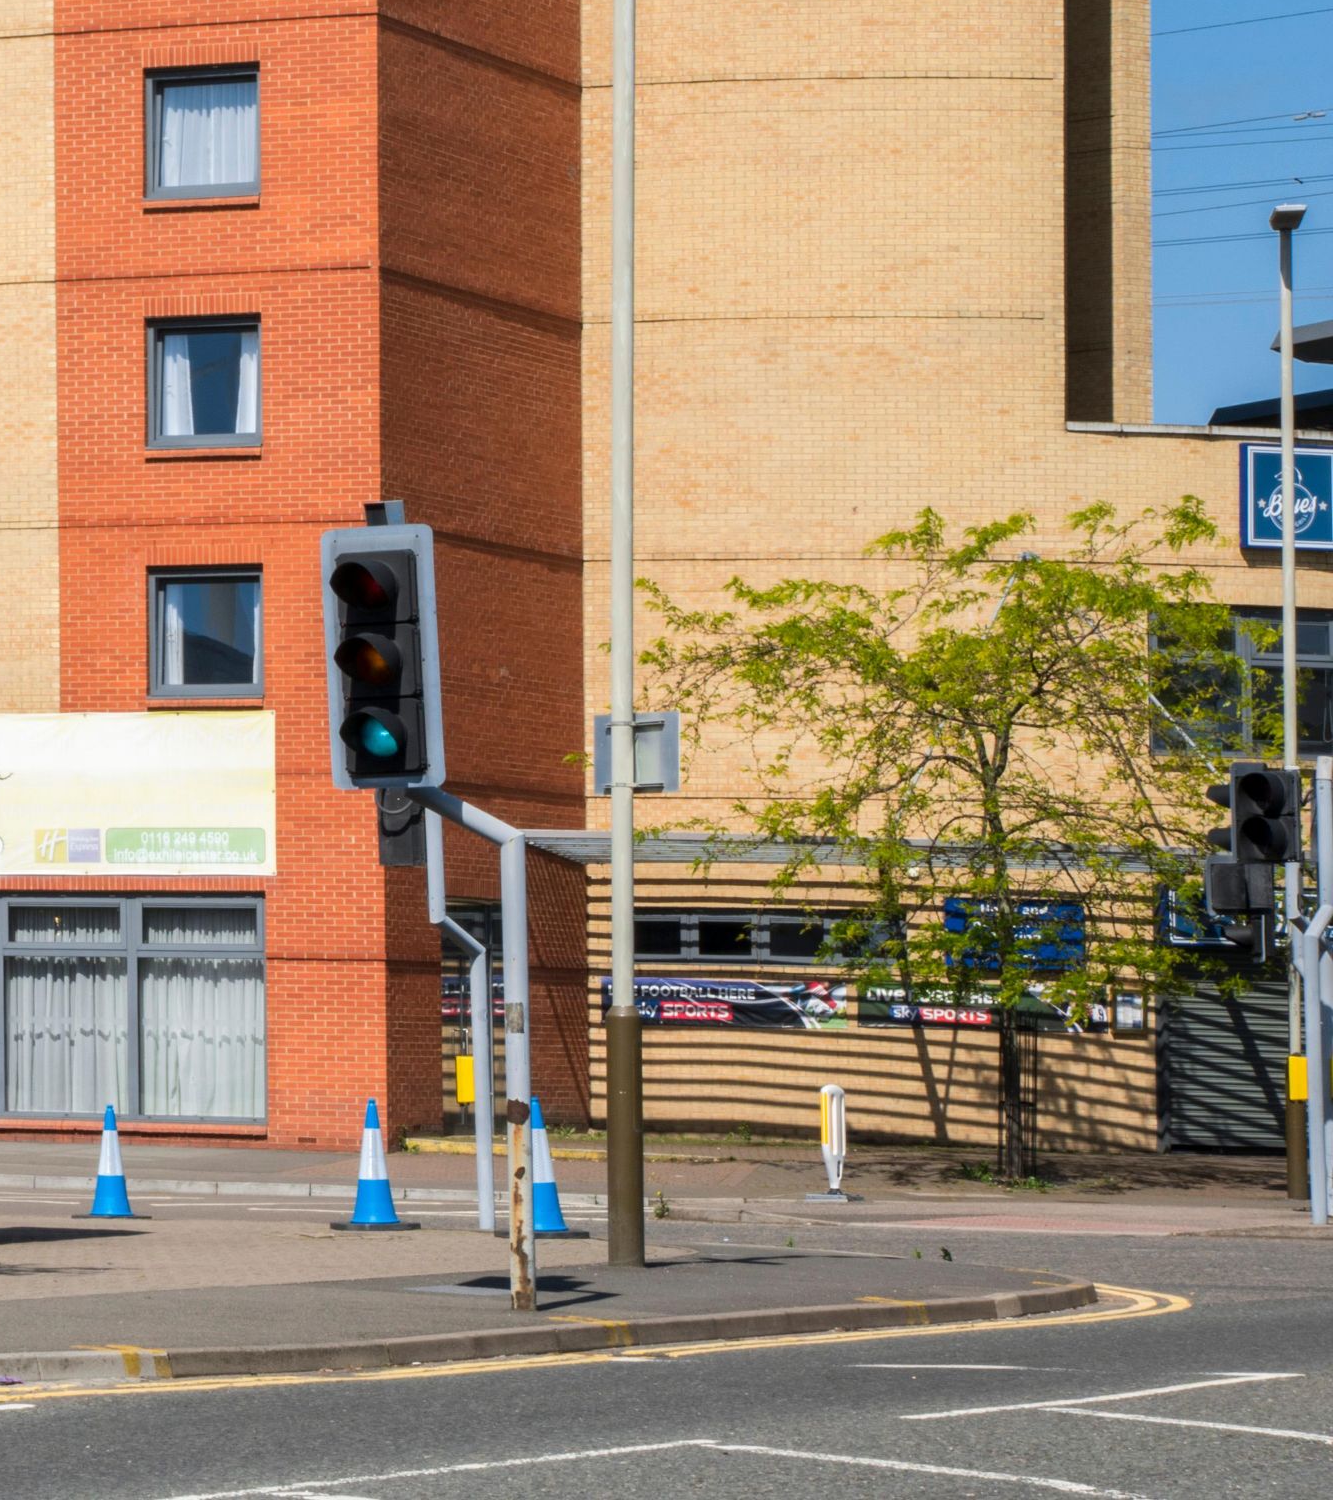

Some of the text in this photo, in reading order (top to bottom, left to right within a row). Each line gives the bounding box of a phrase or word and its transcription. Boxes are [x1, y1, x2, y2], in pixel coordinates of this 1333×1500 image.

[1262, 493, 1318, 518] Bes
[140, 831, 171, 845] 0116
[641, 985, 715, 999] FOOTBALL
[717, 988, 756, 1000] HERE
[662, 1003, 729, 1018] SPORTS
[892, 1005, 988, 1022] sky SPORTS
